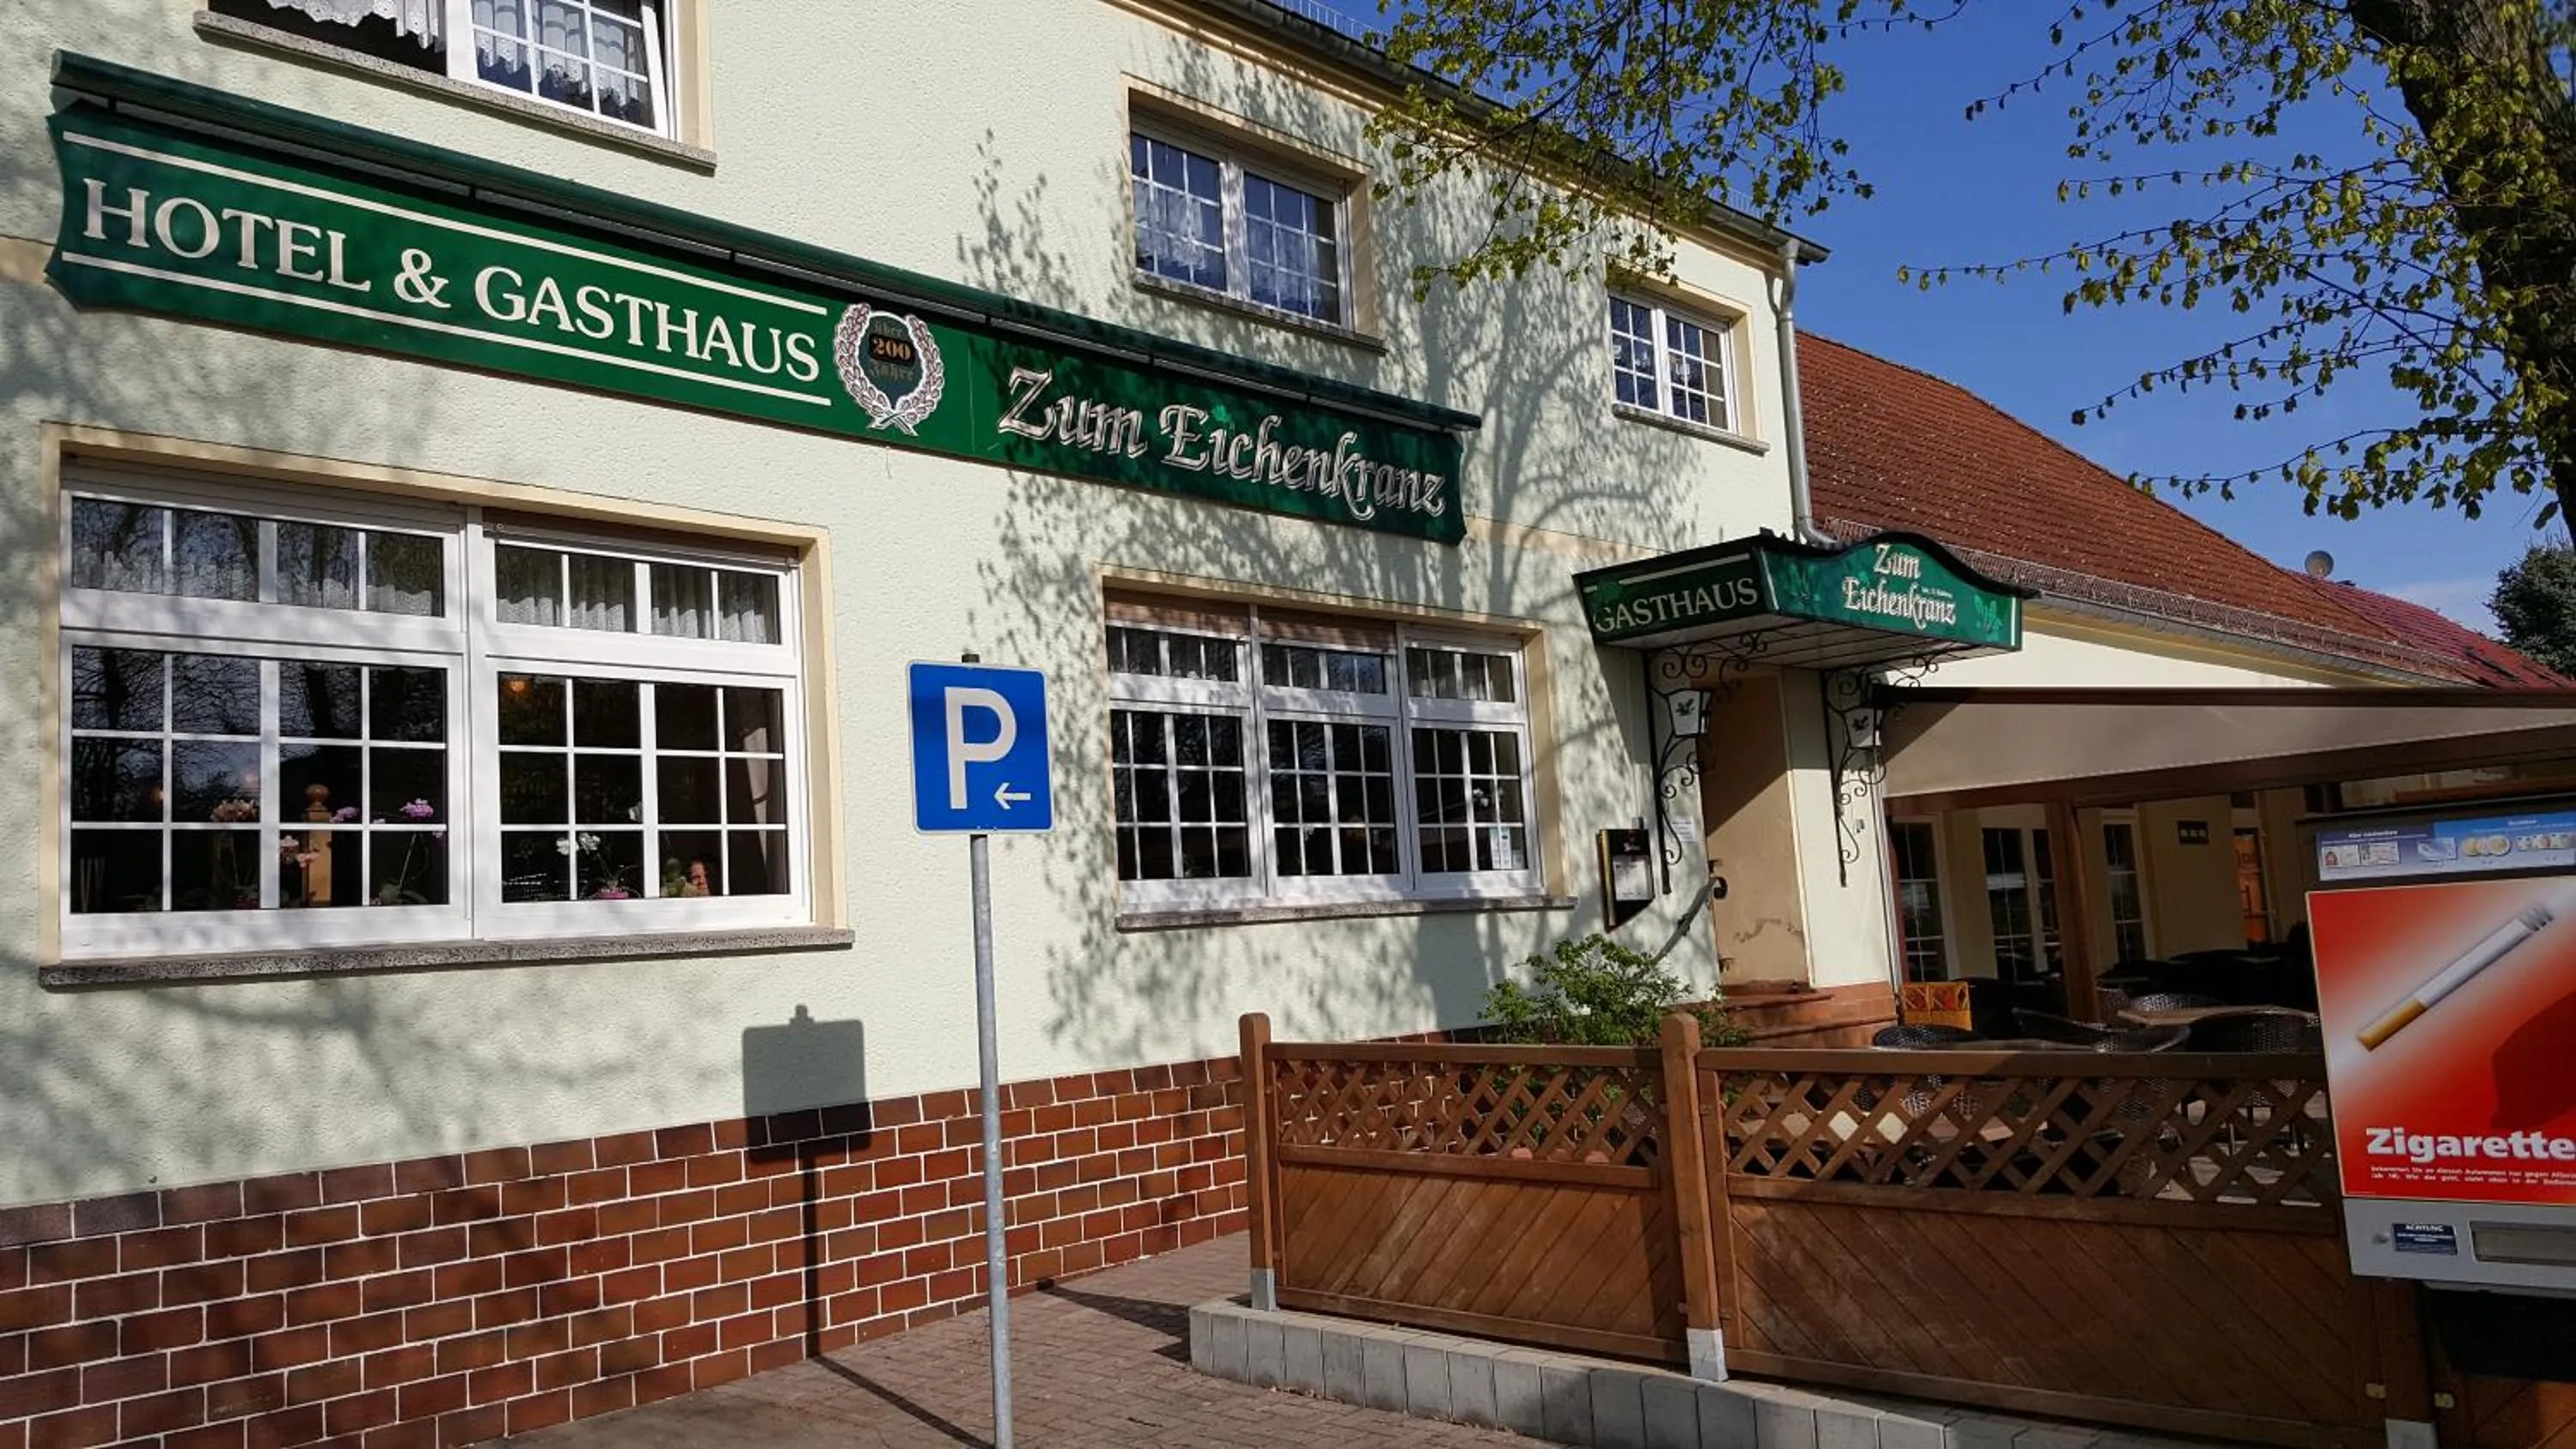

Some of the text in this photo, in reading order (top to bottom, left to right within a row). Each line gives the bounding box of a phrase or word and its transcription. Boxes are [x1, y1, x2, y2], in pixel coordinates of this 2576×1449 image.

[82, 177, 821, 383] HOTEL & GASTHAUS
[872, 336, 912, 361] 200
[997, 366, 1447, 519] Zum Eichenkranz
[1874, 543, 1922, 579] Zum
[1593, 577, 1759, 633] GASTHAUS
[1842, 576, 1957, 630] Eichenkranz
[945, 686, 1018, 810] P
